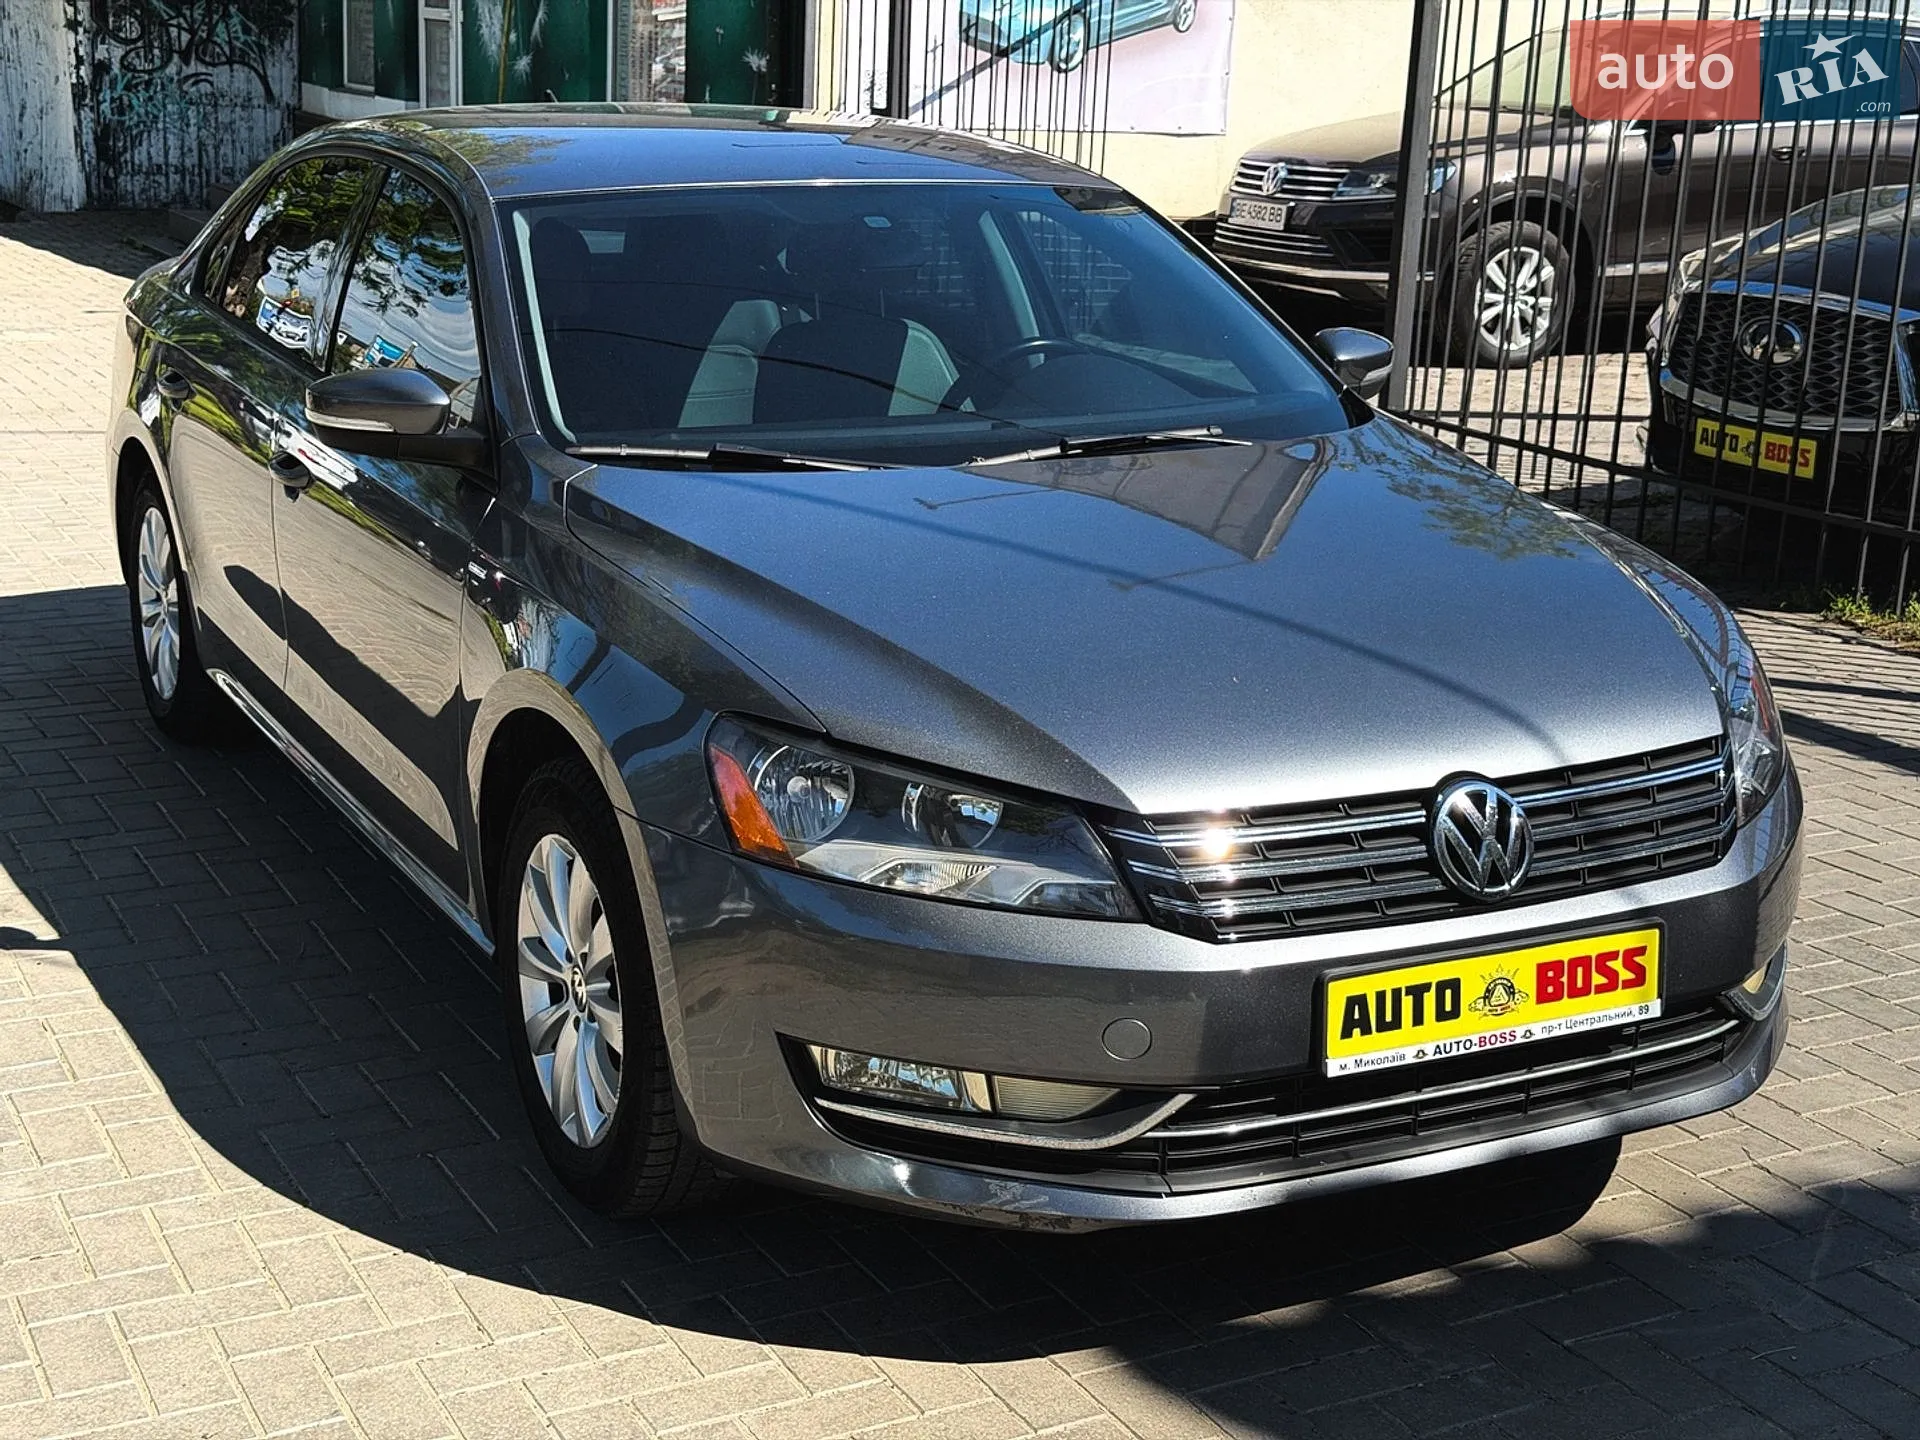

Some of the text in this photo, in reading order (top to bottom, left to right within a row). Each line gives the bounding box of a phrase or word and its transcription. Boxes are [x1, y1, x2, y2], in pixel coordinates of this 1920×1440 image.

[1764, 441, 1811, 468] BOS
[1340, 945, 1648, 1040] AUTO BOSS
[1354, 1052, 1406, 1070] Миколаїв
[1433, 1030, 1517, 1057] AUTO-BOSS
[1541, 1023, 1563, 1035] пр-т
[1565, 1008, 1636, 1030] Центральний,
[1638, 1004, 1650, 1017] 89
